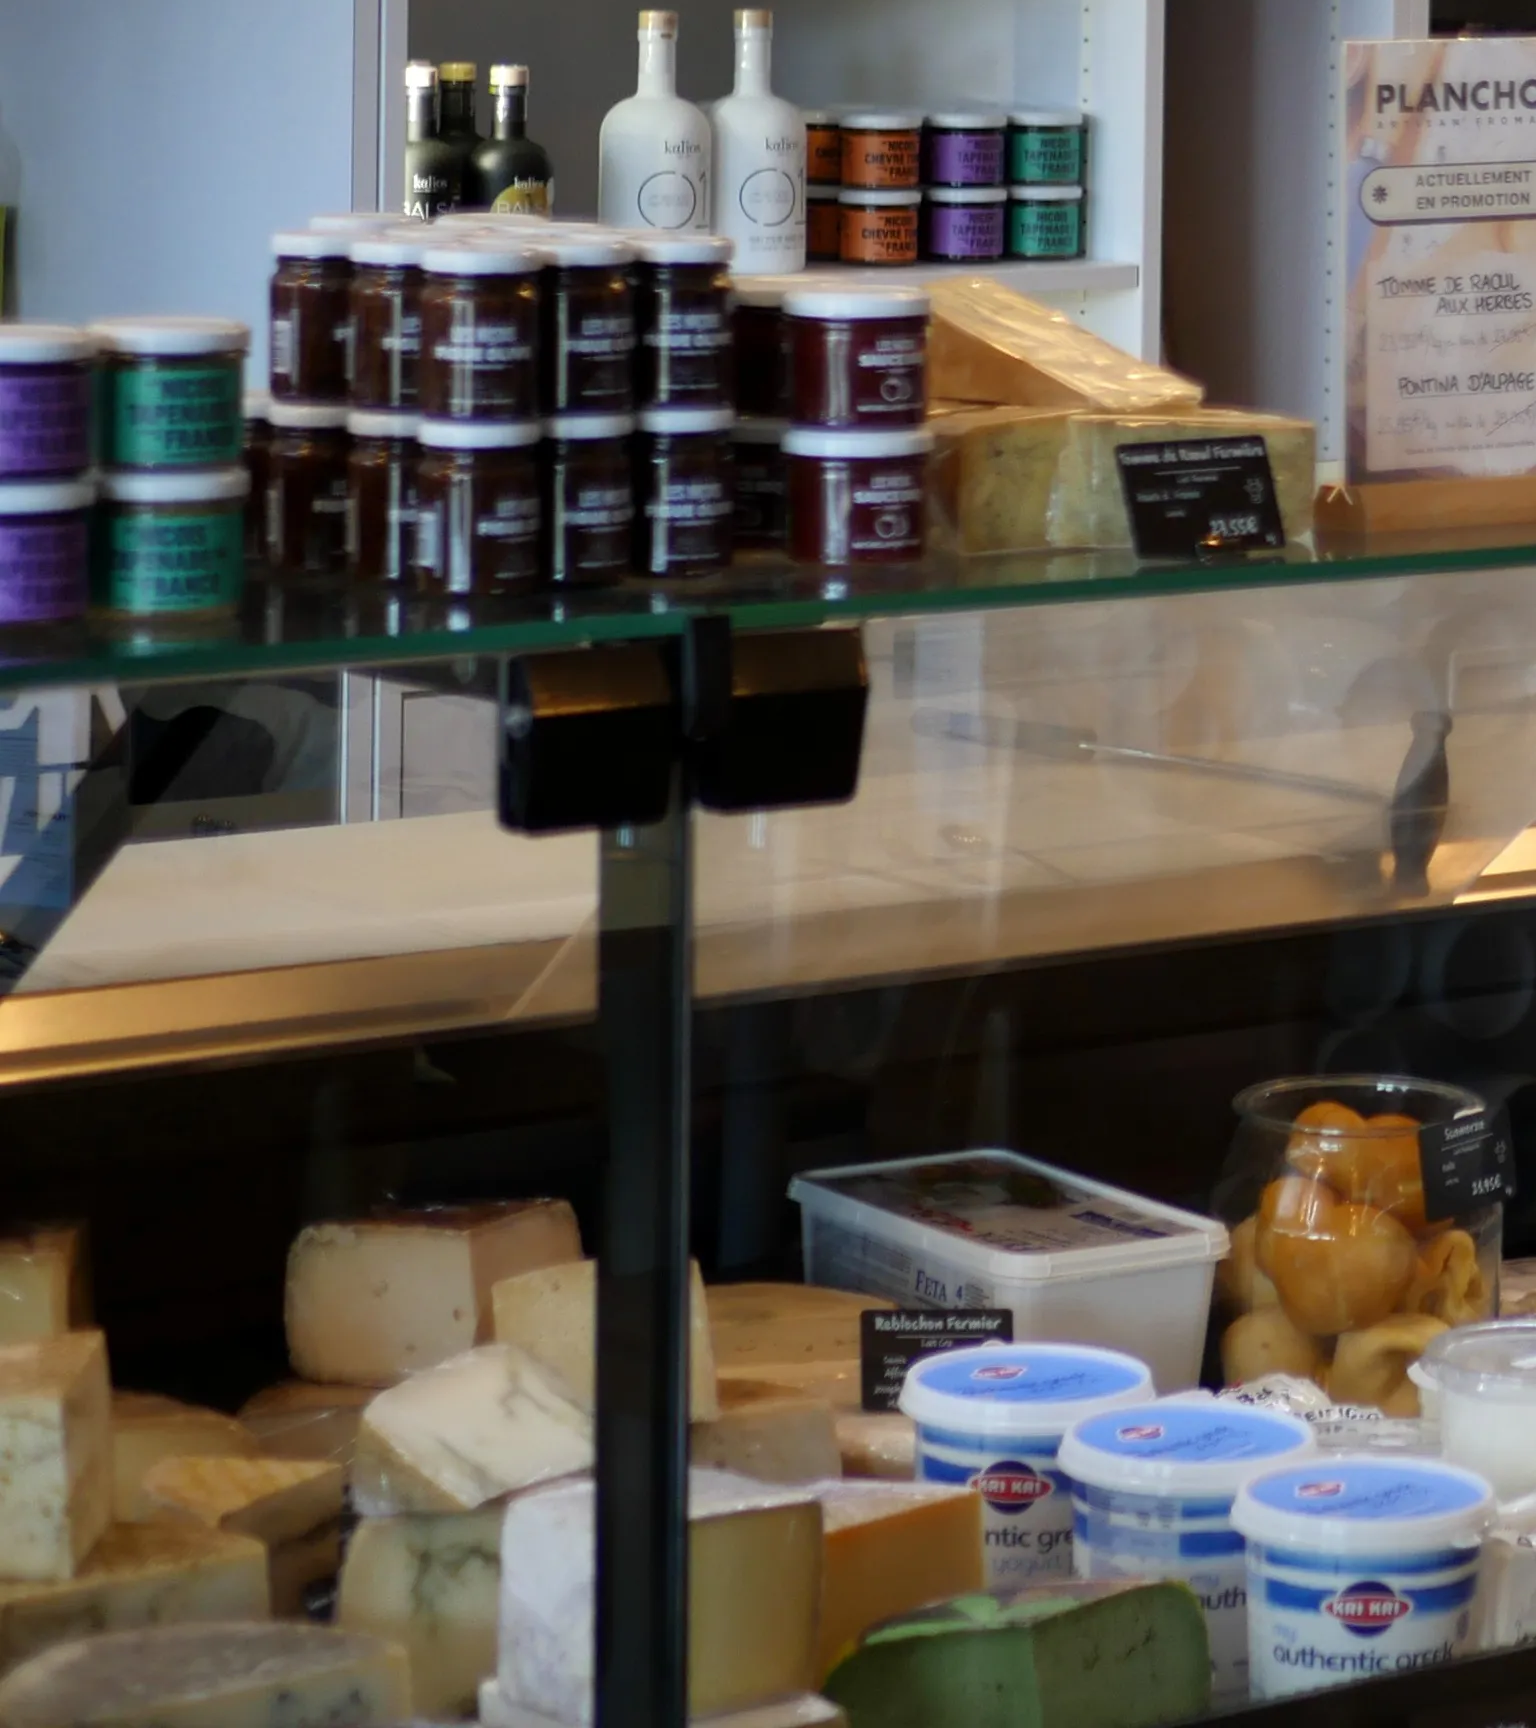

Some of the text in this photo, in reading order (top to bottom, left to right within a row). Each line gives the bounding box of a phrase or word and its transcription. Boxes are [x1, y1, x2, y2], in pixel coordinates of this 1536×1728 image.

[1415, 170, 1533, 189] ACTUELLEMENT
[1415, 192, 1531, 210] EN PROMOTION
[1375, 273, 1520, 296] TOMME DE RAOUL
[1435, 291, 1534, 314] AUX HERBES
[1398, 372, 1536, 395] FONTINA D'ALPAGE
[914, 1269, 948, 1301] FETA
[874, 1312, 1003, 1332] Reblochon Fermier
[1037, 1525, 1074, 1555] gre
[1333, 1599, 1400, 1616] KRI KRI
[1272, 1639, 1389, 1673] authentic
